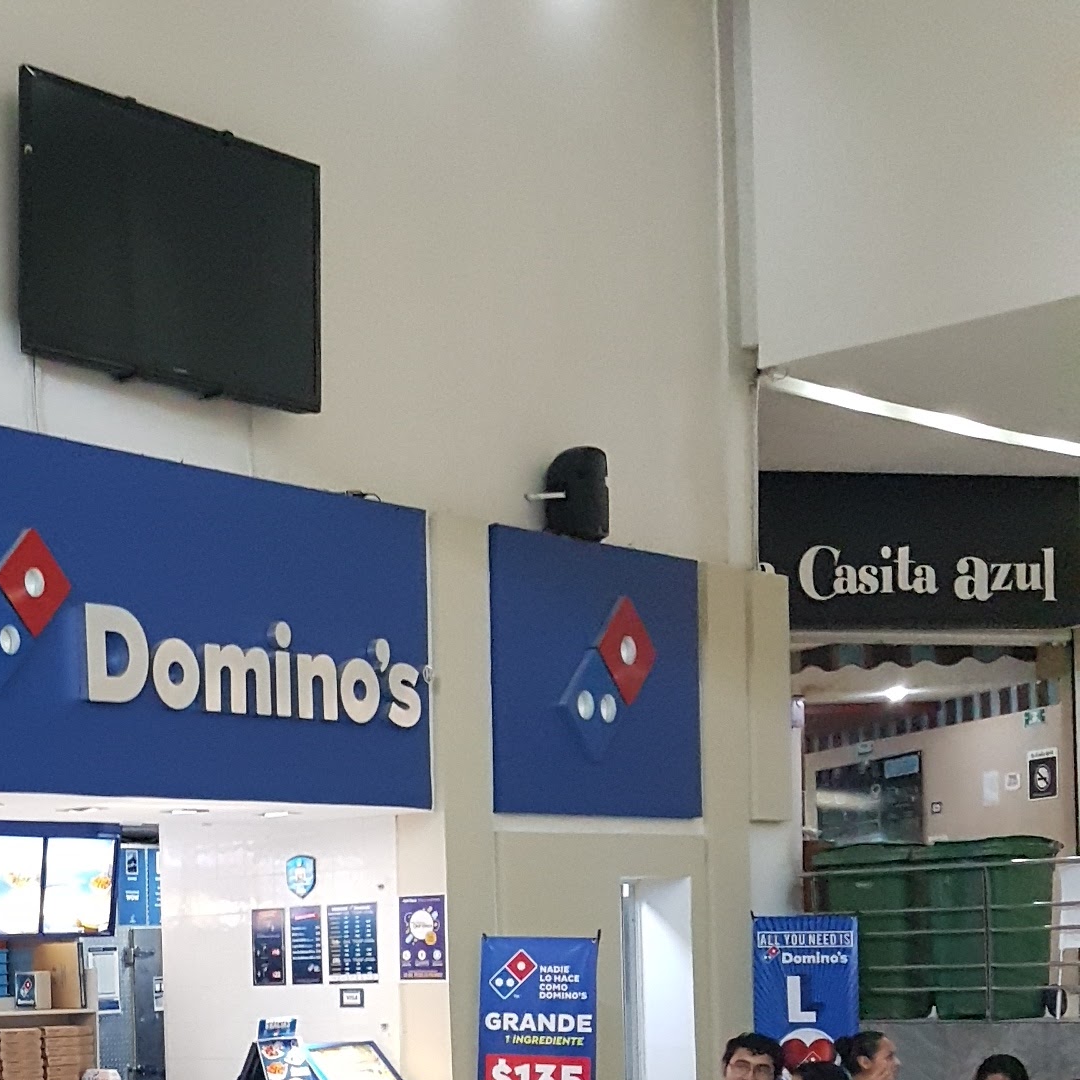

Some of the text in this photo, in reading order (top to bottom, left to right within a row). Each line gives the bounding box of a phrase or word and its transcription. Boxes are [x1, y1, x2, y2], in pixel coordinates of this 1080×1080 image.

[799, 545, 1057, 601] Casita azul
[85, 602, 422, 728] Domino's
[760, 933, 851, 946] ALL YOU NEED IS
[781, 951, 849, 965] Domino's
[539, 965, 570, 974] NADIE
[539, 974, 580, 983] LO HACE
[539, 983, 568, 991] COMO
[539, 991, 588, 1000] DOMINO'S
[786, 975, 817, 1023] L
[484, 1012, 593, 1033] GRANDE
[505, 1034, 585, 1046] 1 INGREDIENTE
